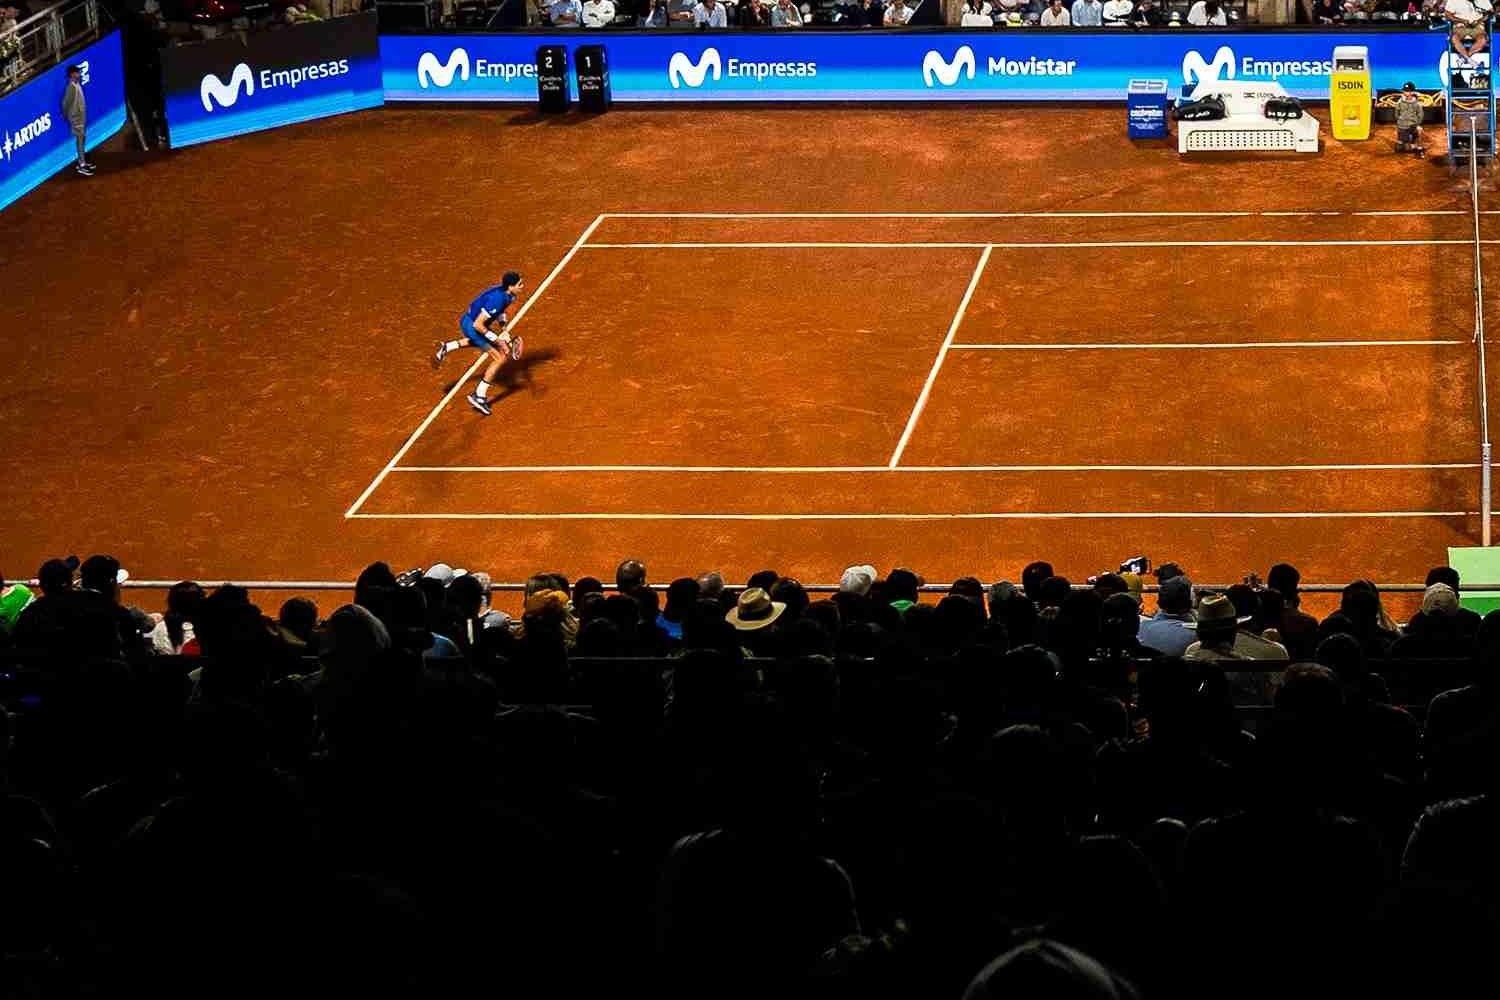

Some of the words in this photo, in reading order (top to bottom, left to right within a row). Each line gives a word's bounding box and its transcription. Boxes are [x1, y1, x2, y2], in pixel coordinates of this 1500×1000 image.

[545, 56, 553, 68] 2
[585, 56, 591, 68] 1
[728, 58, 817, 79] Empresas
[988, 56, 1076, 75] Movistar
[1242, 58, 1332, 80] Empresas
[260, 59, 349, 88] Empresas
[1338, 81, 1364, 90] ISDIN
[14, 113, 51, 149] ARTOIS
